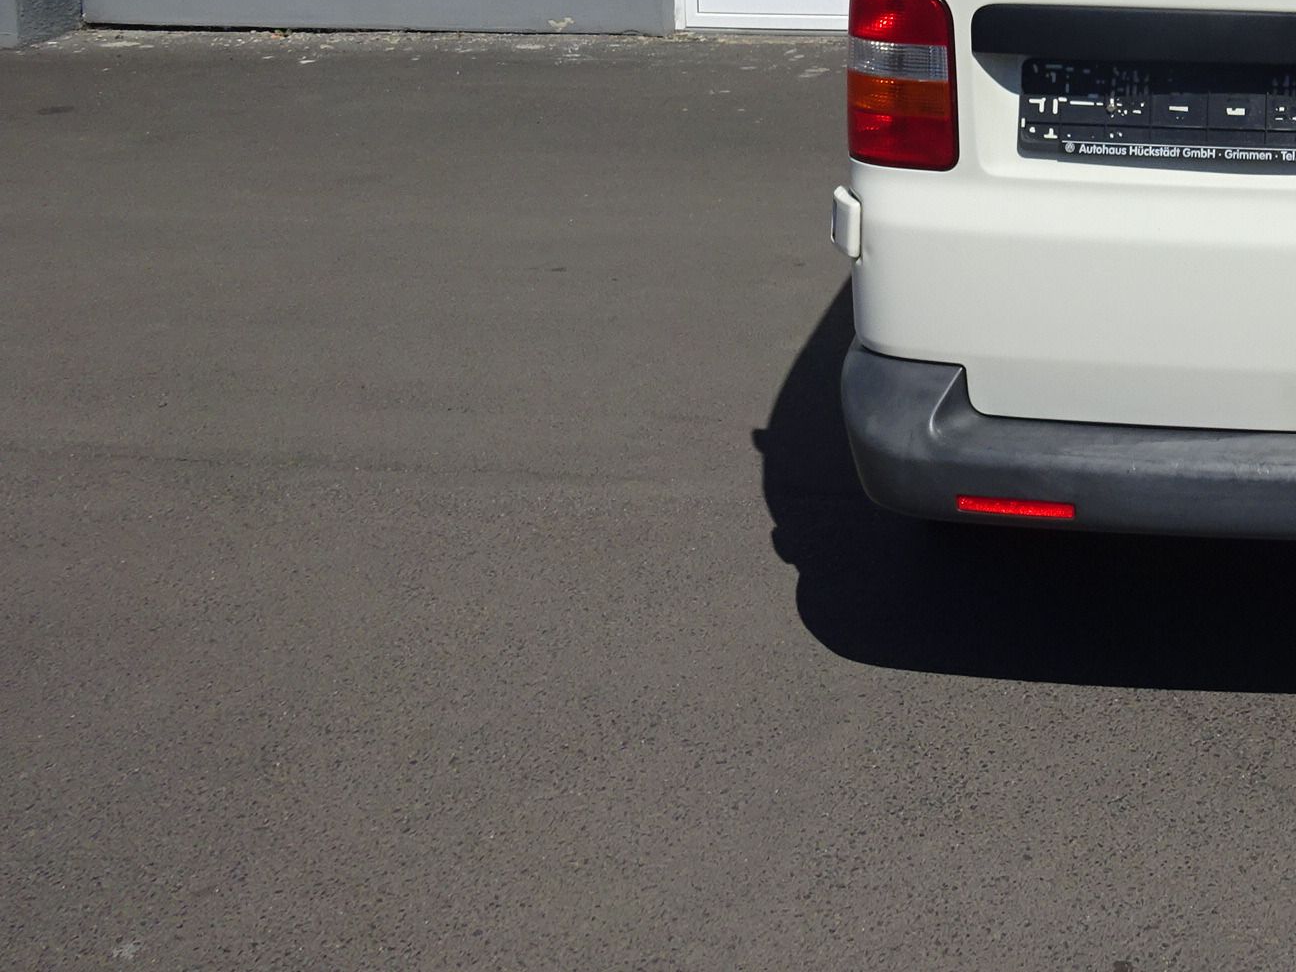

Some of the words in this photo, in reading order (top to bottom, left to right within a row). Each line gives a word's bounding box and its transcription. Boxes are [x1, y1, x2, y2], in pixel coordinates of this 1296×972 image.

[1078, 142, 1128, 156] Autohaus
[1128, 145, 1181, 158] Hückstädt
[1182, 147, 1216, 159] GmbH
[1224, 148, 1273, 161] Grimmen
